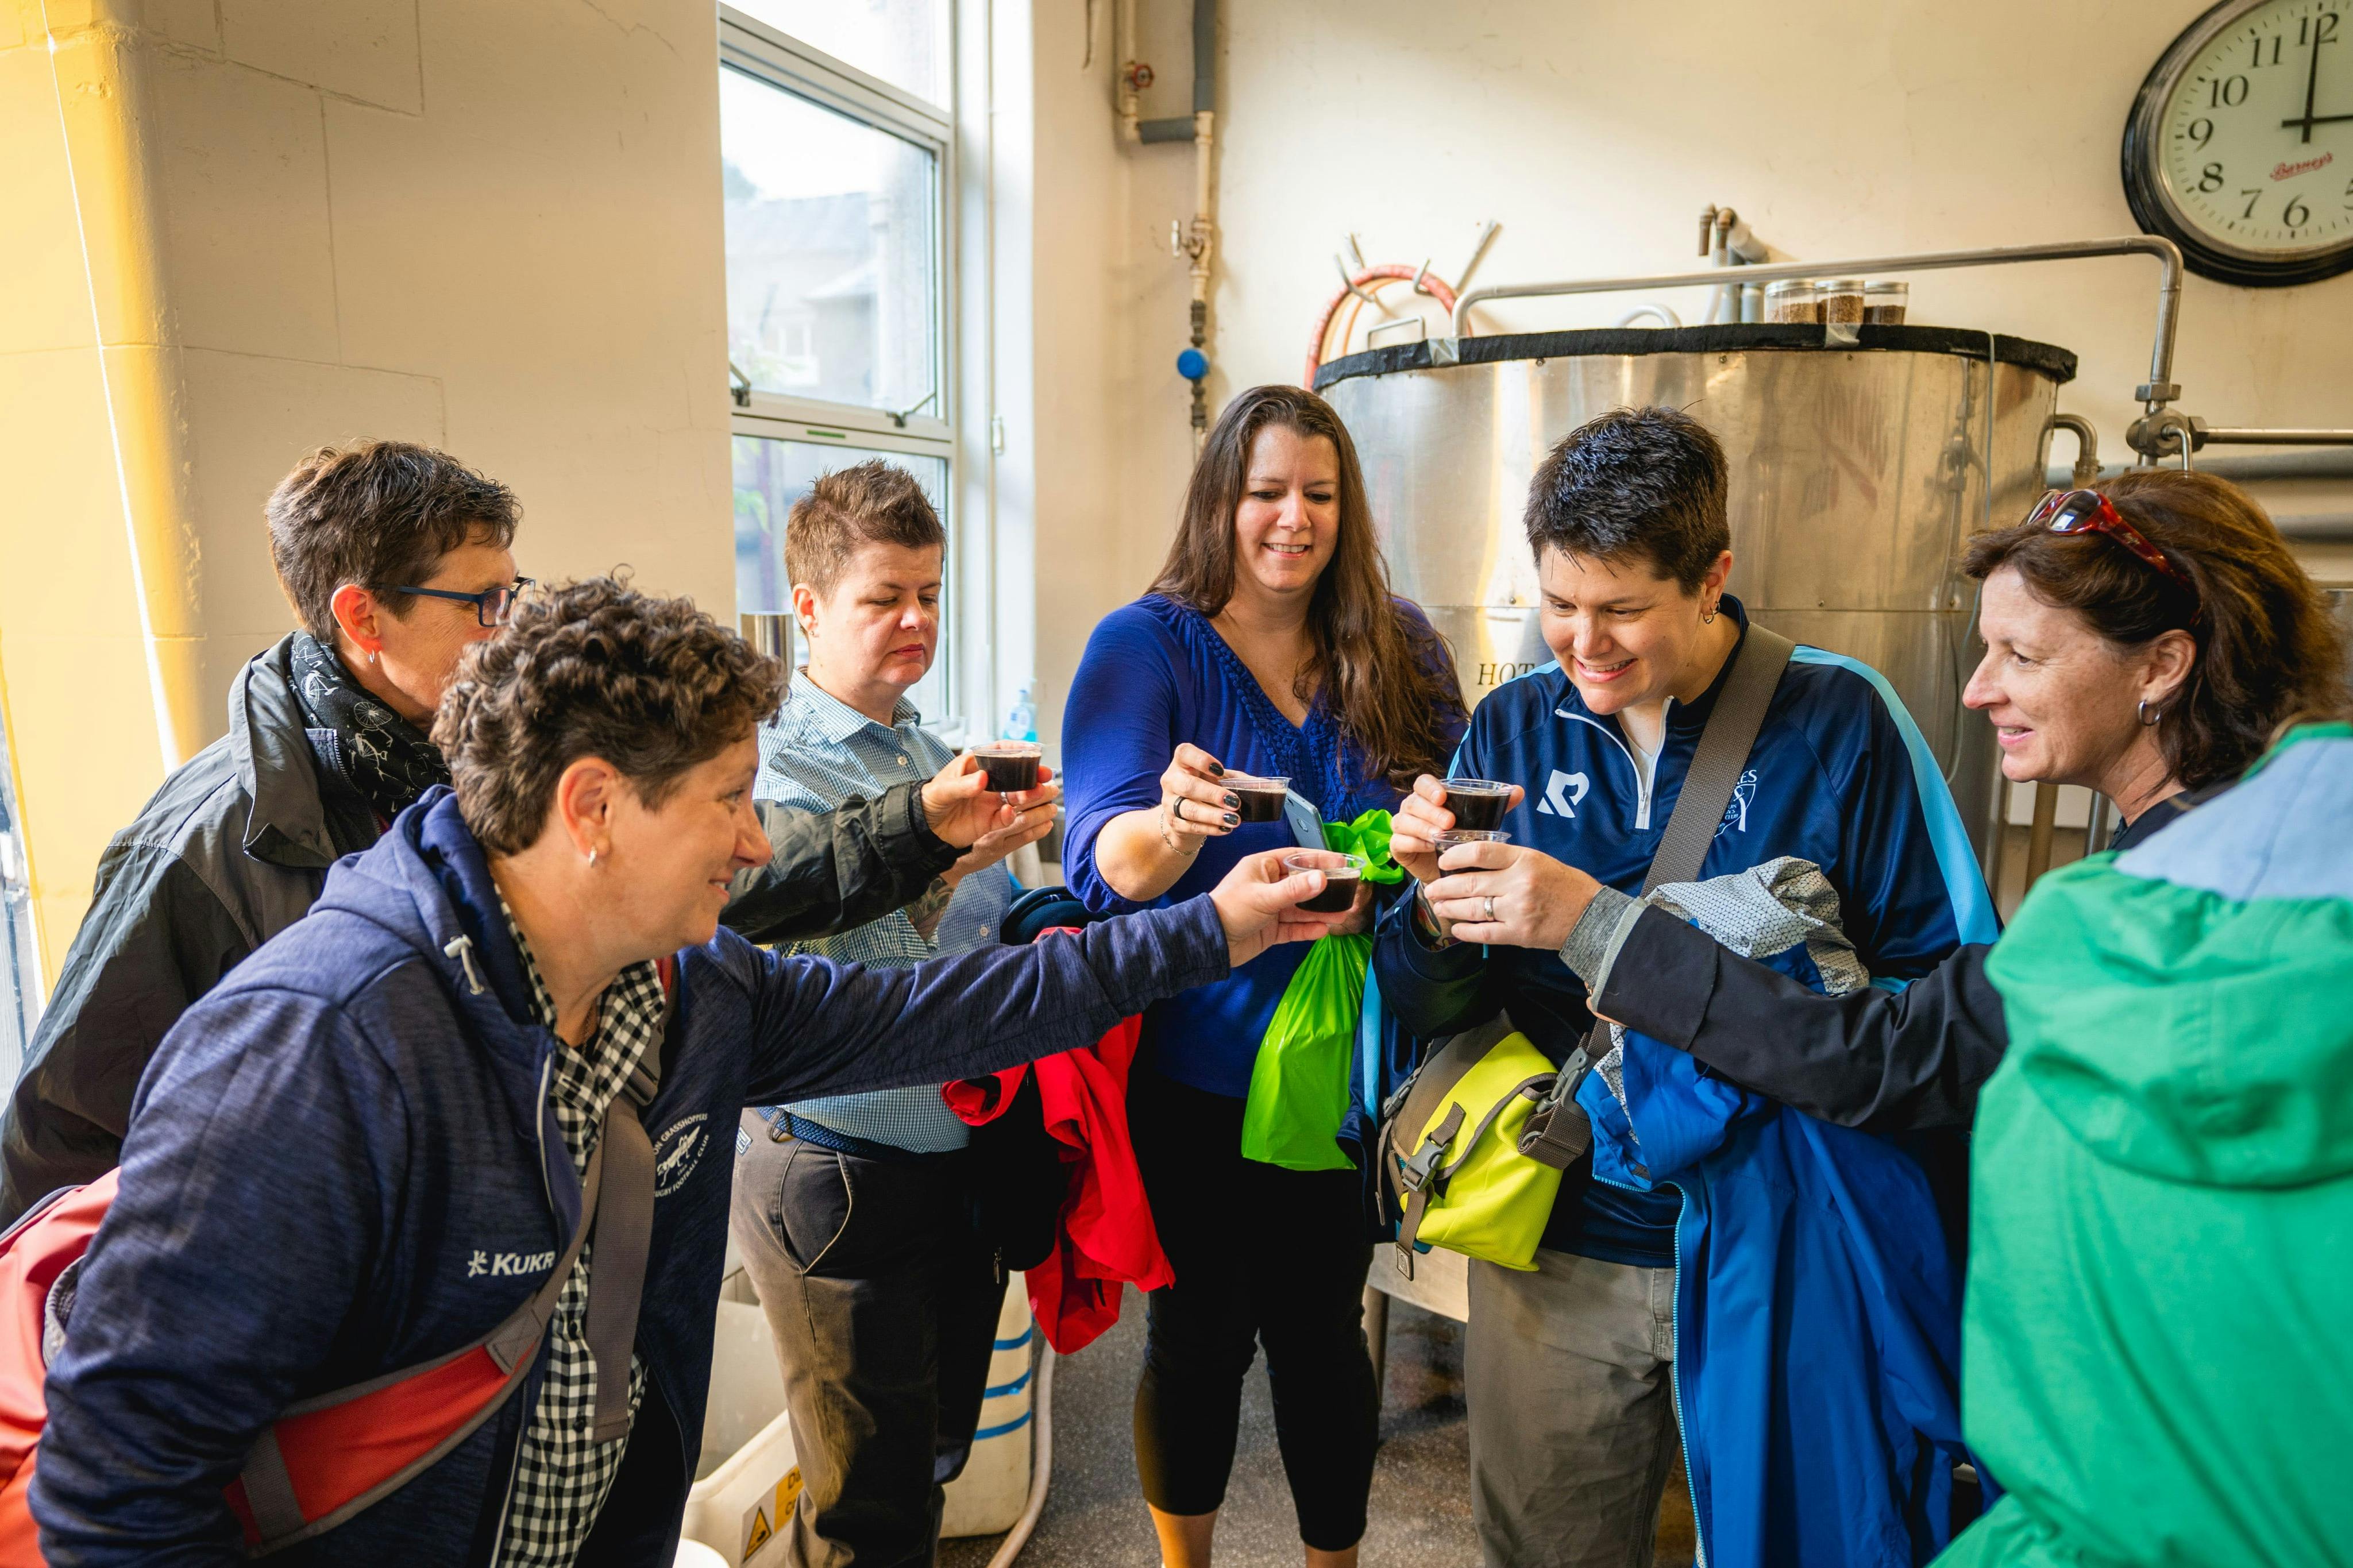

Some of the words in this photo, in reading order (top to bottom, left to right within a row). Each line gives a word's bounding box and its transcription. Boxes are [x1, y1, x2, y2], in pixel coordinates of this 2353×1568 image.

[2296, 12, 2340, 47] 12
[2248, 34, 2283, 69] 11
[2207, 75, 2249, 109] 10
[2188, 117, 2214, 153] 9
[2198, 162, 2224, 193] 8
[2241, 188, 2263, 219] 7
[2283, 194, 2309, 229] 6
[1478, 663, 1535, 685] HOT
[1737, 770, 1757, 785] ES
[661, 1113, 708, 1142] GRASSHOPPERS
[654, 1187, 672, 1198] UGBY
[673, 1159, 699, 1192] FOOTBALL
[697, 1134, 709, 1157] CLUB
